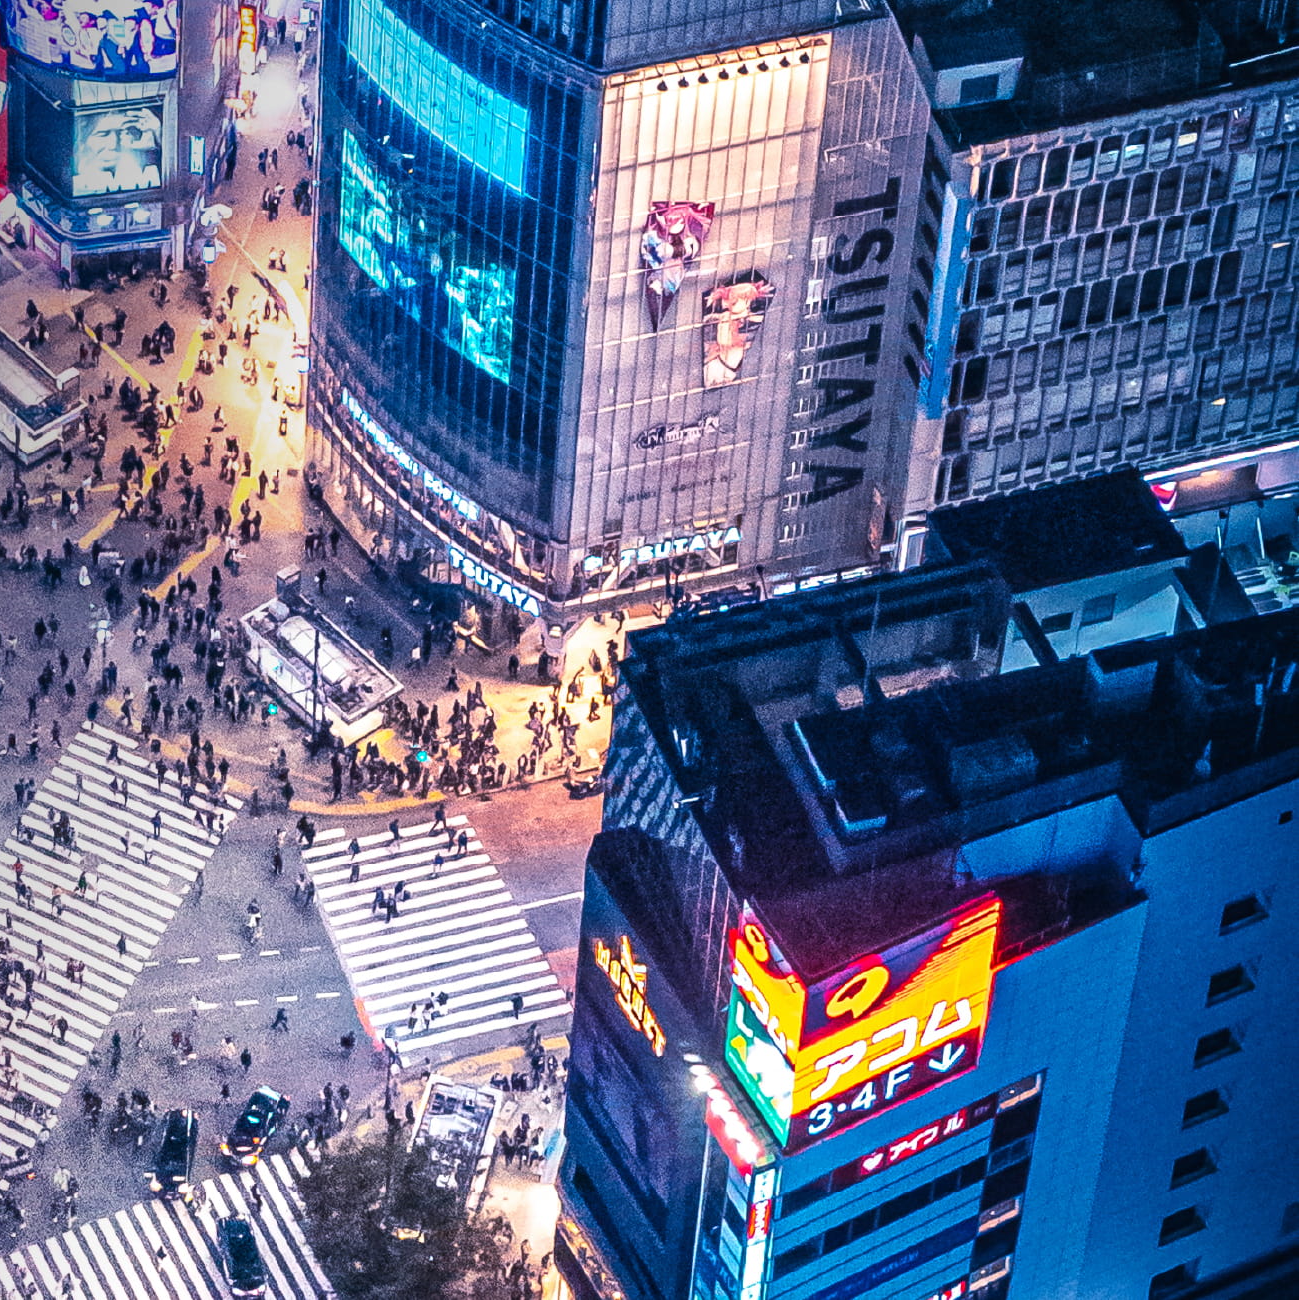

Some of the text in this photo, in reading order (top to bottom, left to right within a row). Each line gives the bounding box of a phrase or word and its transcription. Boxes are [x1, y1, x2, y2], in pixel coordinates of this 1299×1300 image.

[800, 176, 901, 506] TSUTAYA
[620, 527, 742, 565] TSUTAYA
[449, 547, 541, 617] TSUTAYA
[810, 997, 972, 1100] アコム
[889, 1112, 964, 1161] アイフル
